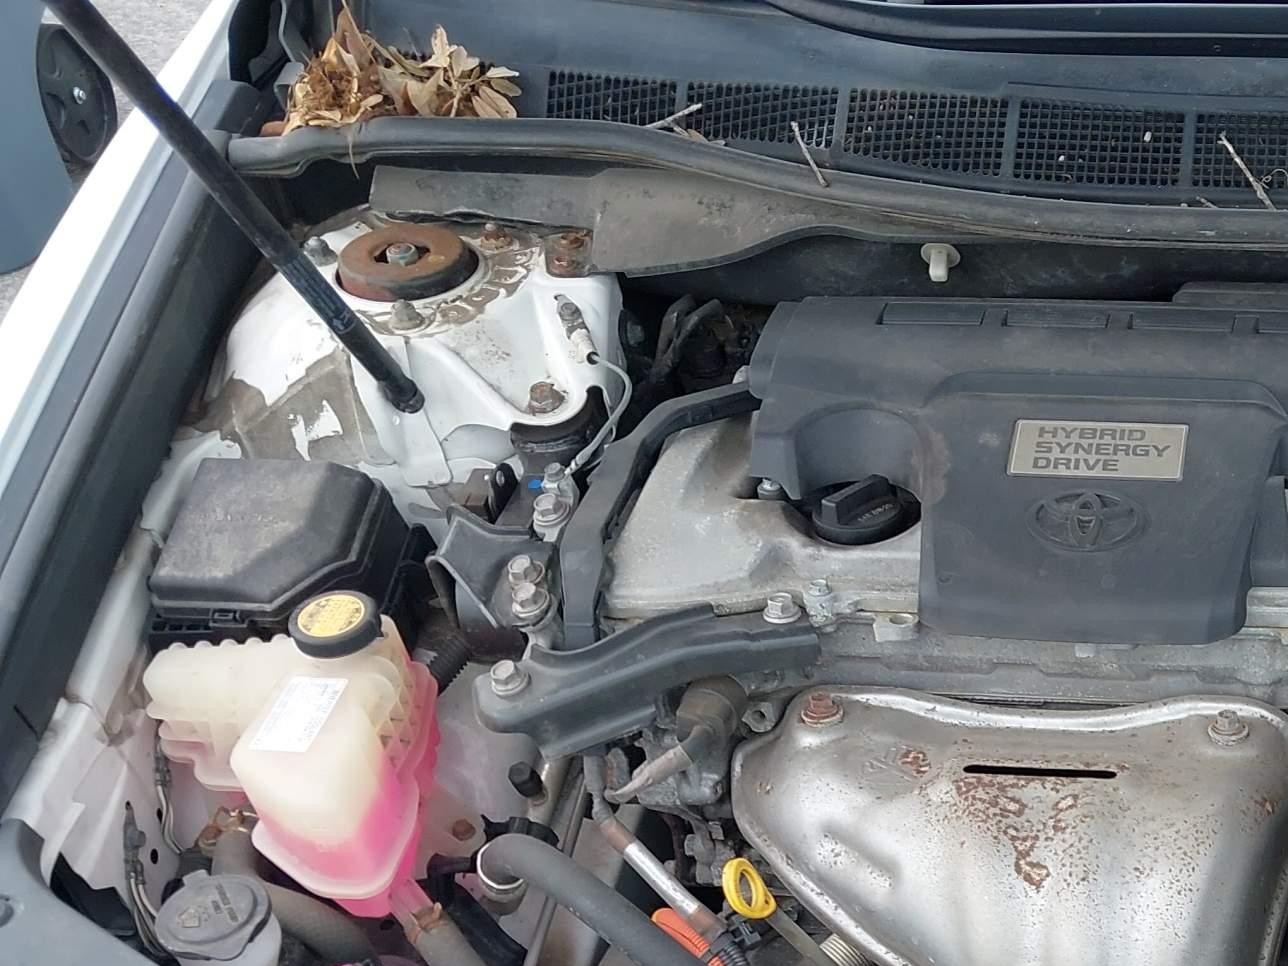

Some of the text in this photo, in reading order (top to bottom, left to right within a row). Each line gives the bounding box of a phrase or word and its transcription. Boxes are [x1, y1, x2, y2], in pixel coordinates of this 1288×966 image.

[1038, 426, 1146, 441] HYBRID
[1034, 441, 1171, 457] SYNERGY
[1032, 456, 1119, 471] DRIVE
